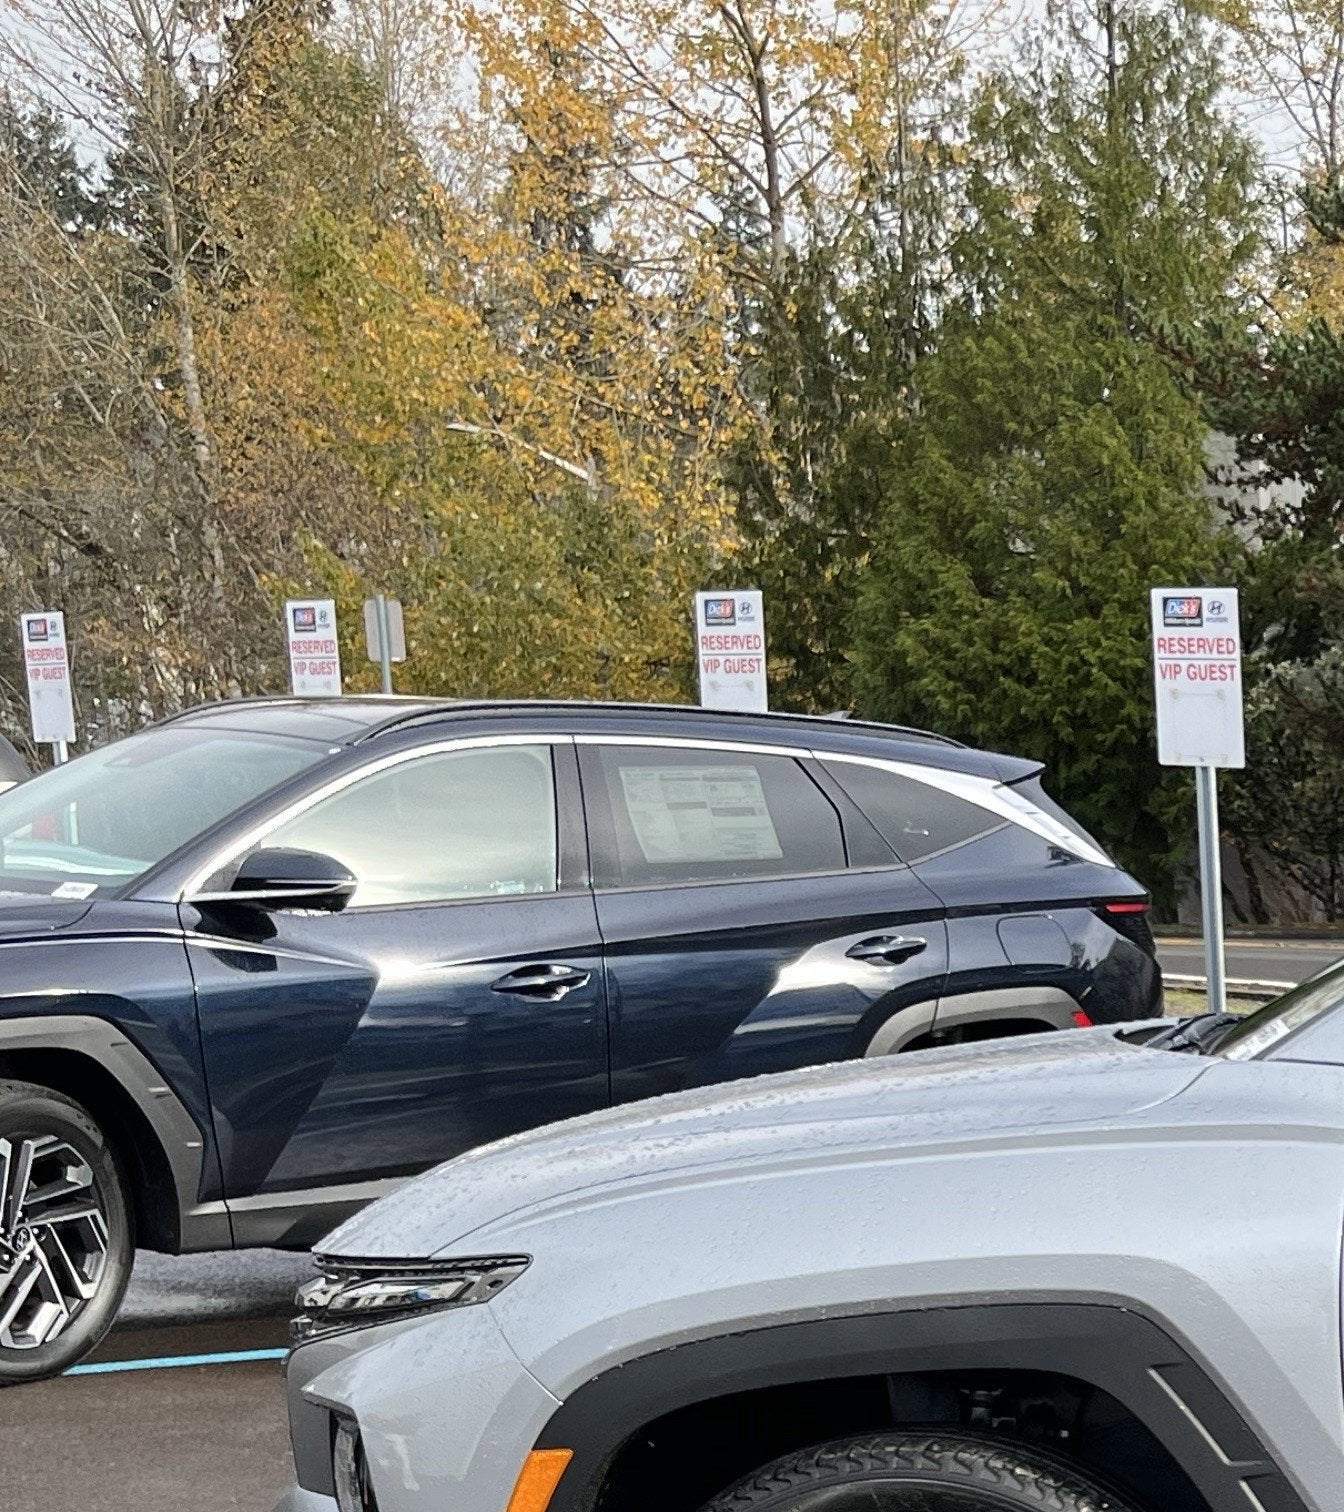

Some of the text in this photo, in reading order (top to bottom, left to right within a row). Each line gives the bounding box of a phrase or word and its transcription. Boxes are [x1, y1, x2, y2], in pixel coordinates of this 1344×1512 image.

[292, 640, 336, 654] RESERVED
[701, 635, 761, 650] RESERVED
[1157, 637, 1236, 655] RESERVED
[293, 661, 337, 676] VIP GUEST
[702, 658, 761, 674] VIP GUEST
[1159, 663, 1236, 681] VIP GUEST
